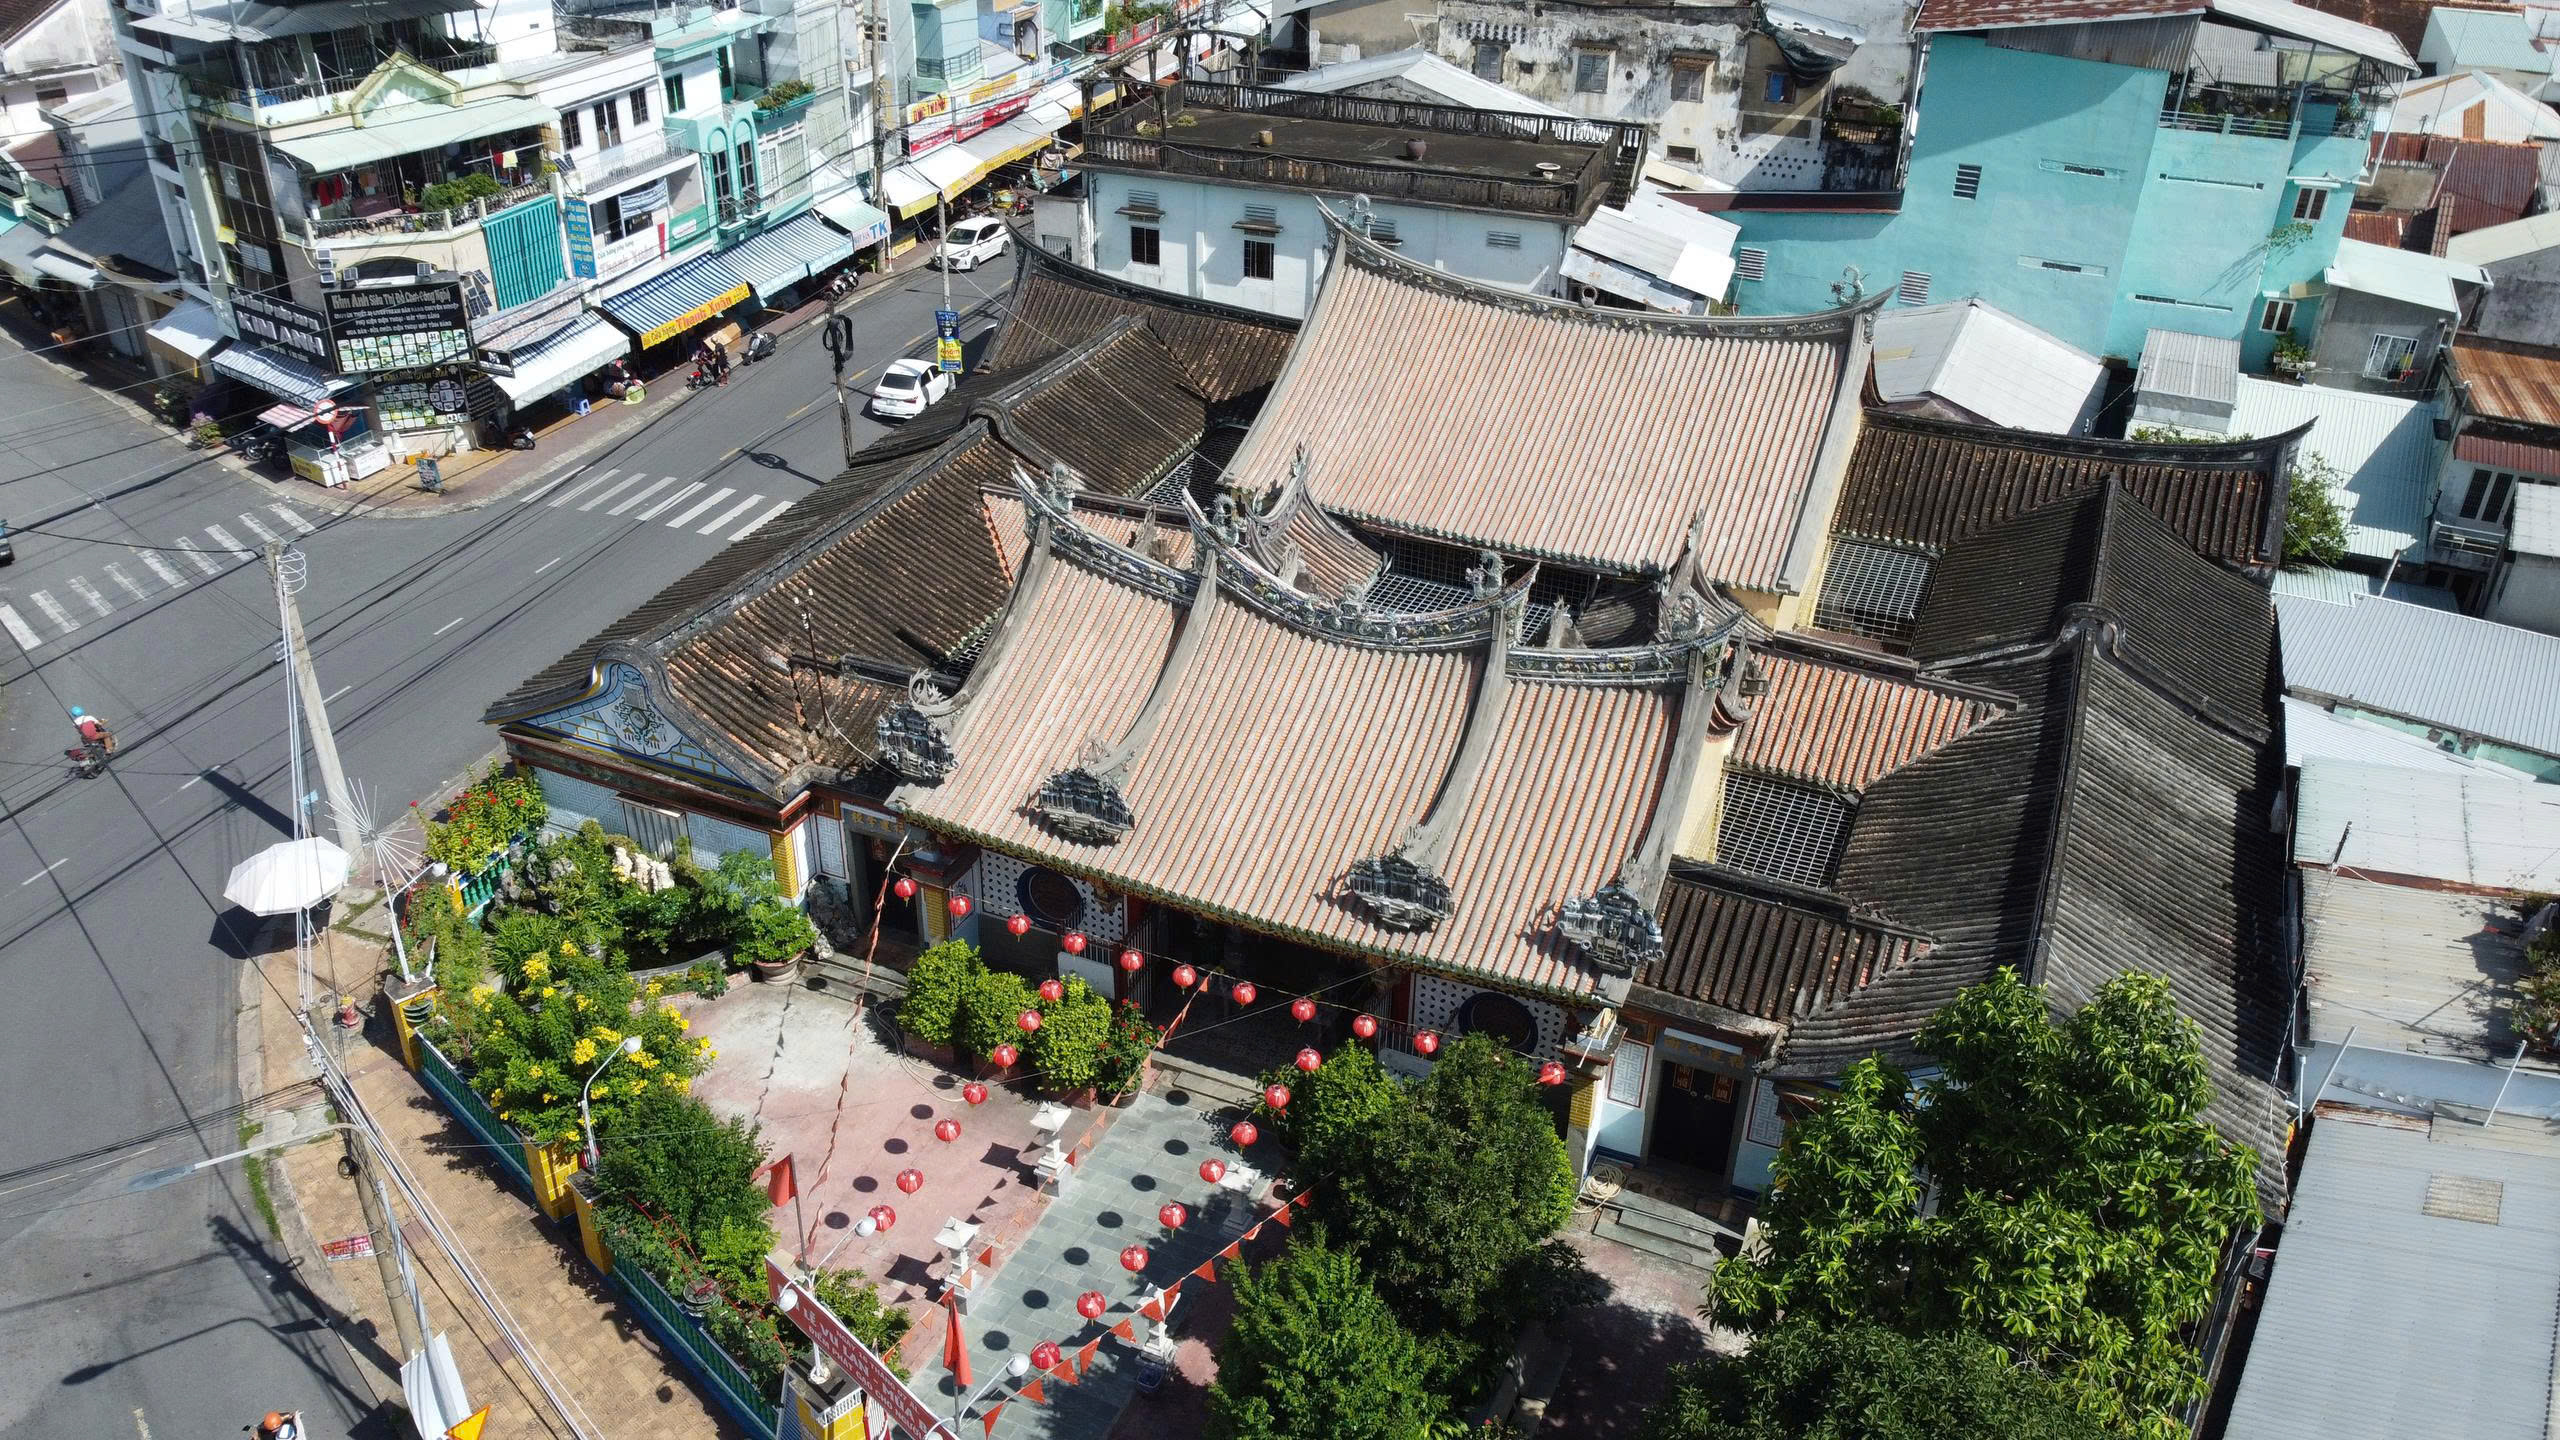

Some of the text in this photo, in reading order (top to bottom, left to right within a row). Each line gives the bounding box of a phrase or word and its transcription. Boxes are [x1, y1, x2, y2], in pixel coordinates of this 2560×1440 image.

[869, 219, 888, 240] TK
[331, 294, 351, 310] Kim
[351, 292, 370, 308] Anh
[675, 308, 707, 331] Thanh
[707, 295, 733, 314] Xuân
[236, 310, 278, 340] KIM
[280, 325, 325, 356] ANH
[820, 1323, 840, 1348] VU
[844, 1348, 870, 1377] LAN
[875, 1390, 893, 1411] CHO
